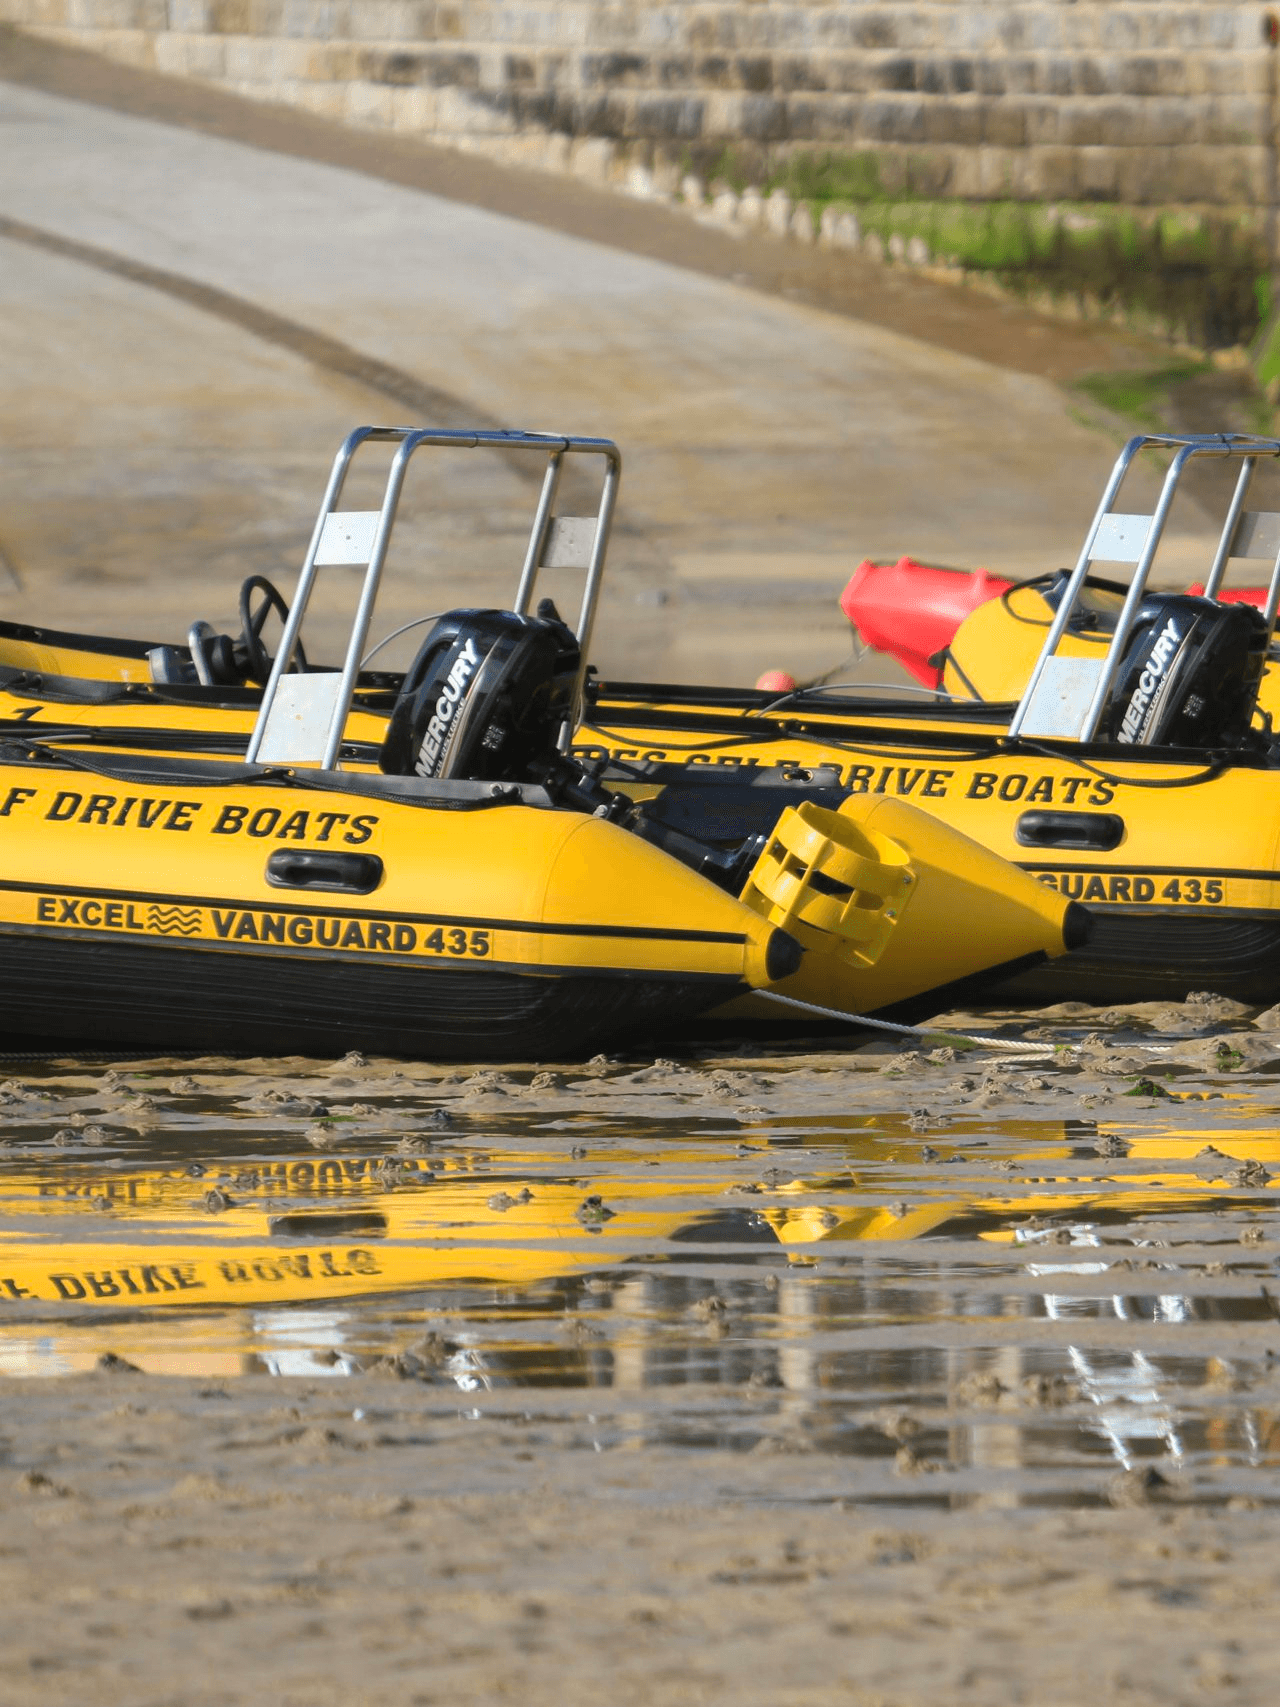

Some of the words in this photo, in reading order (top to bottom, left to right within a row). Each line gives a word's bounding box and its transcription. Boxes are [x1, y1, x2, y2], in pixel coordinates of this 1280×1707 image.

[414, 637, 479, 778] MERCURY
[1117, 617, 1181, 744] MERCURY
[965, 772, 1119, 806] BOATS
[45, 791, 203, 831] DRIVE
[211, 805, 379, 845] BOATS
[1161, 879, 1223, 904] 435
[37, 897, 144, 929] EXCEL
[210, 909, 417, 951] VANGUARD
[424, 928, 490, 956] 435
